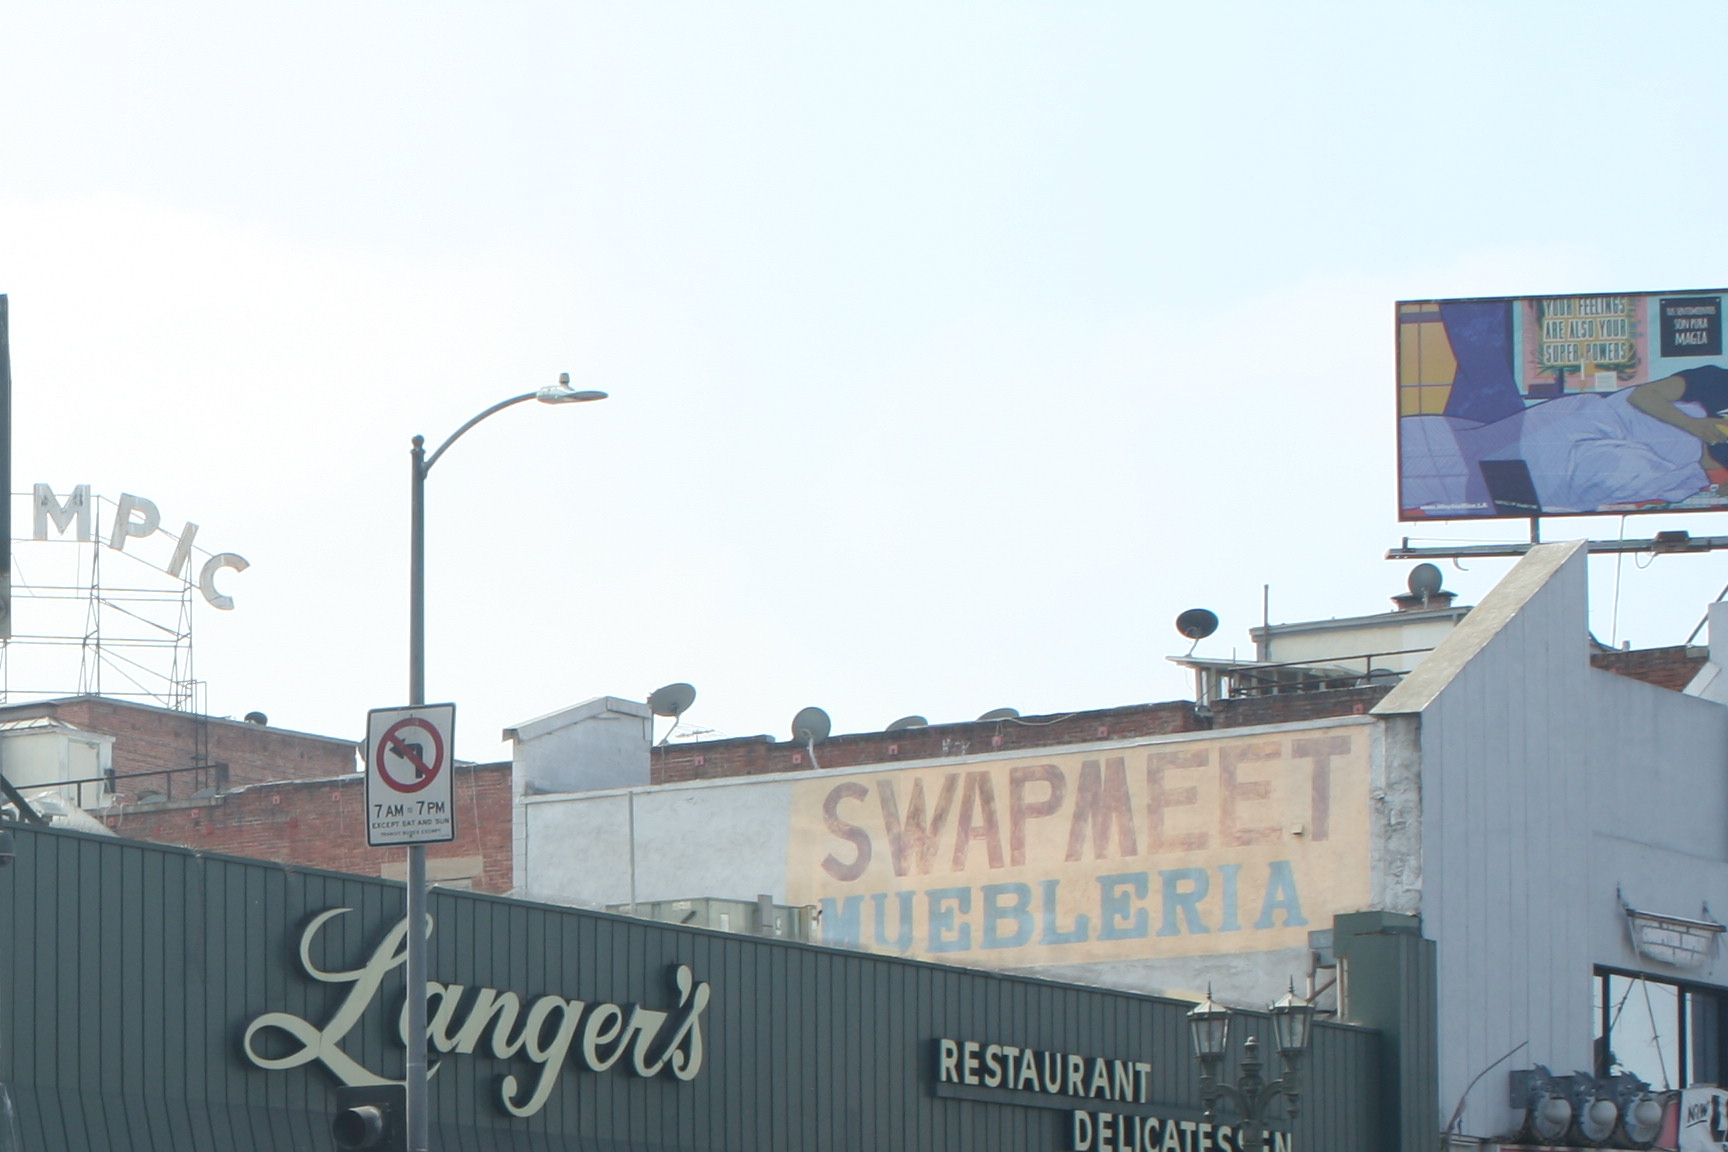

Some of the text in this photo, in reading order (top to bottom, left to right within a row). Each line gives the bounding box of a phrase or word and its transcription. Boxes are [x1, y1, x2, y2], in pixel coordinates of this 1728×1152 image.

[1544, 297, 1626, 316] YOUR FEELINGS
[1545, 318, 1627, 340] ARE ALSO YOUR
[1545, 342, 1626, 363] SUPER POWERS
[819, 860, 1309, 956] MUEBLERIA
[243, 907, 710, 1118] Langer's
[939, 1038, 1151, 1103] RESTAURANT
